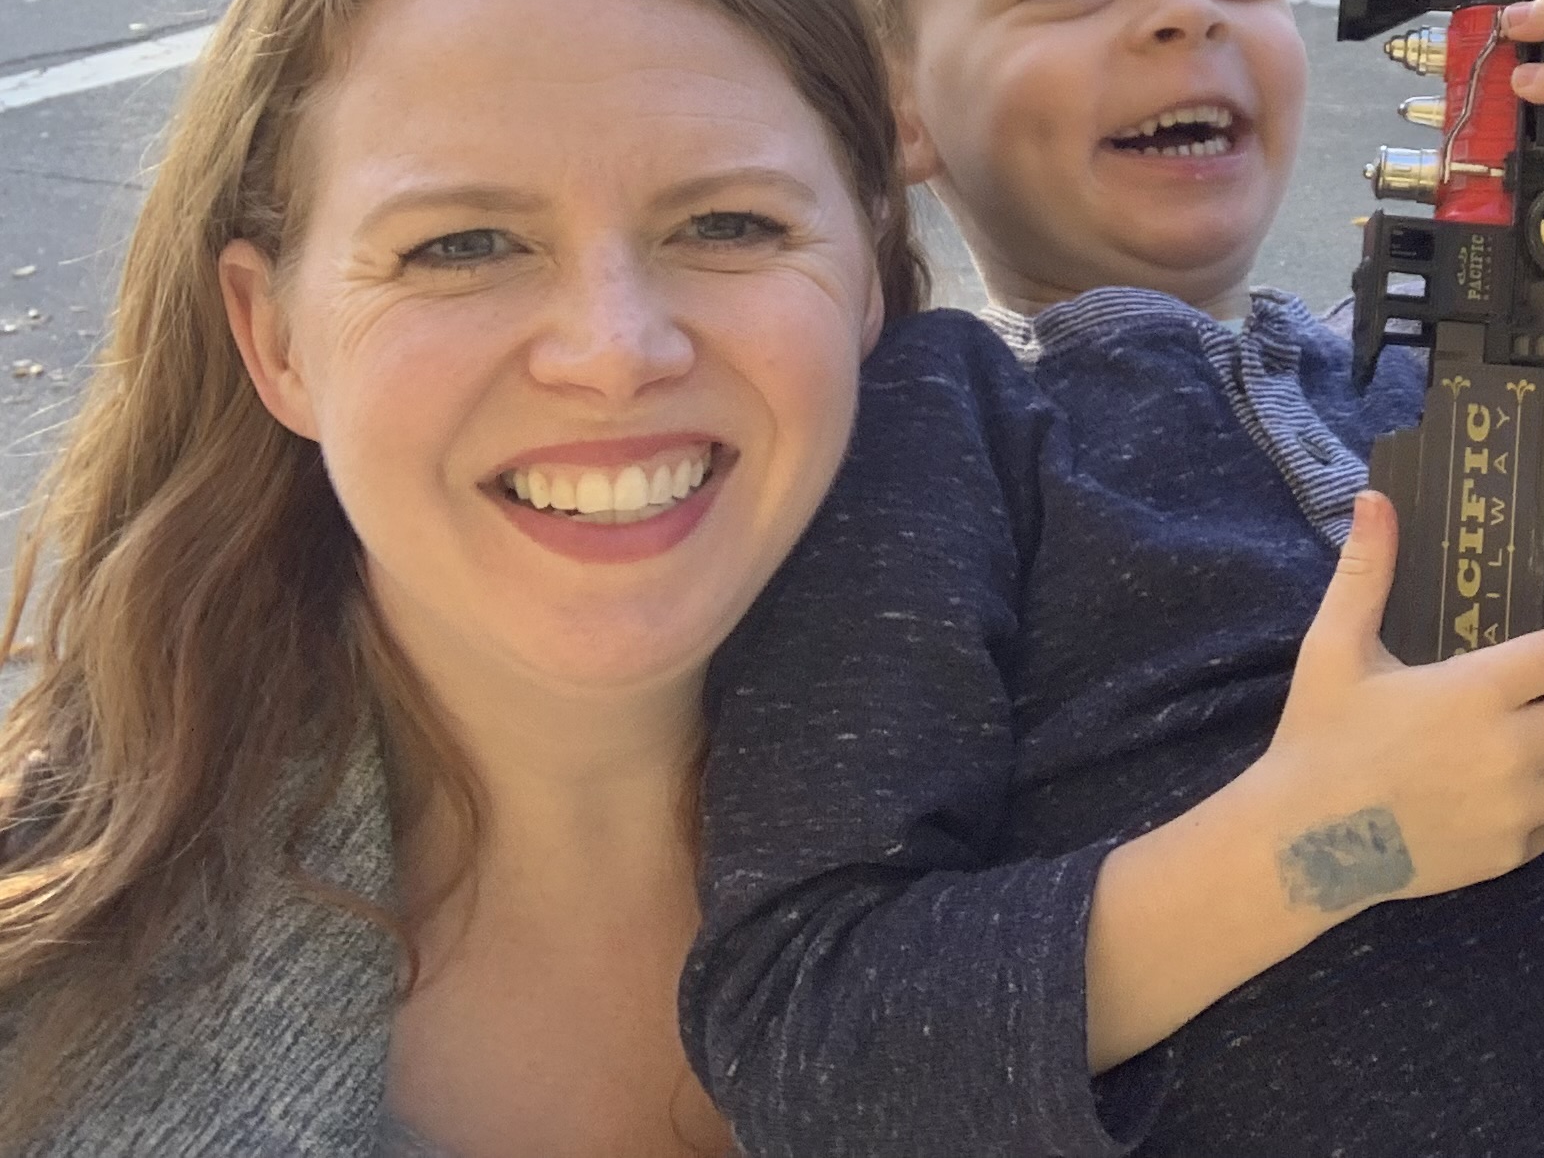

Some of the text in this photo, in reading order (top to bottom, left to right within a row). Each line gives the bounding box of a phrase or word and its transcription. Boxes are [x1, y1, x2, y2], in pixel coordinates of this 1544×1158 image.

[1467, 233, 1485, 300] PACIFIC
[1454, 402, 1491, 655] ACIFIC
[1483, 406, 1510, 644] AILWAY
